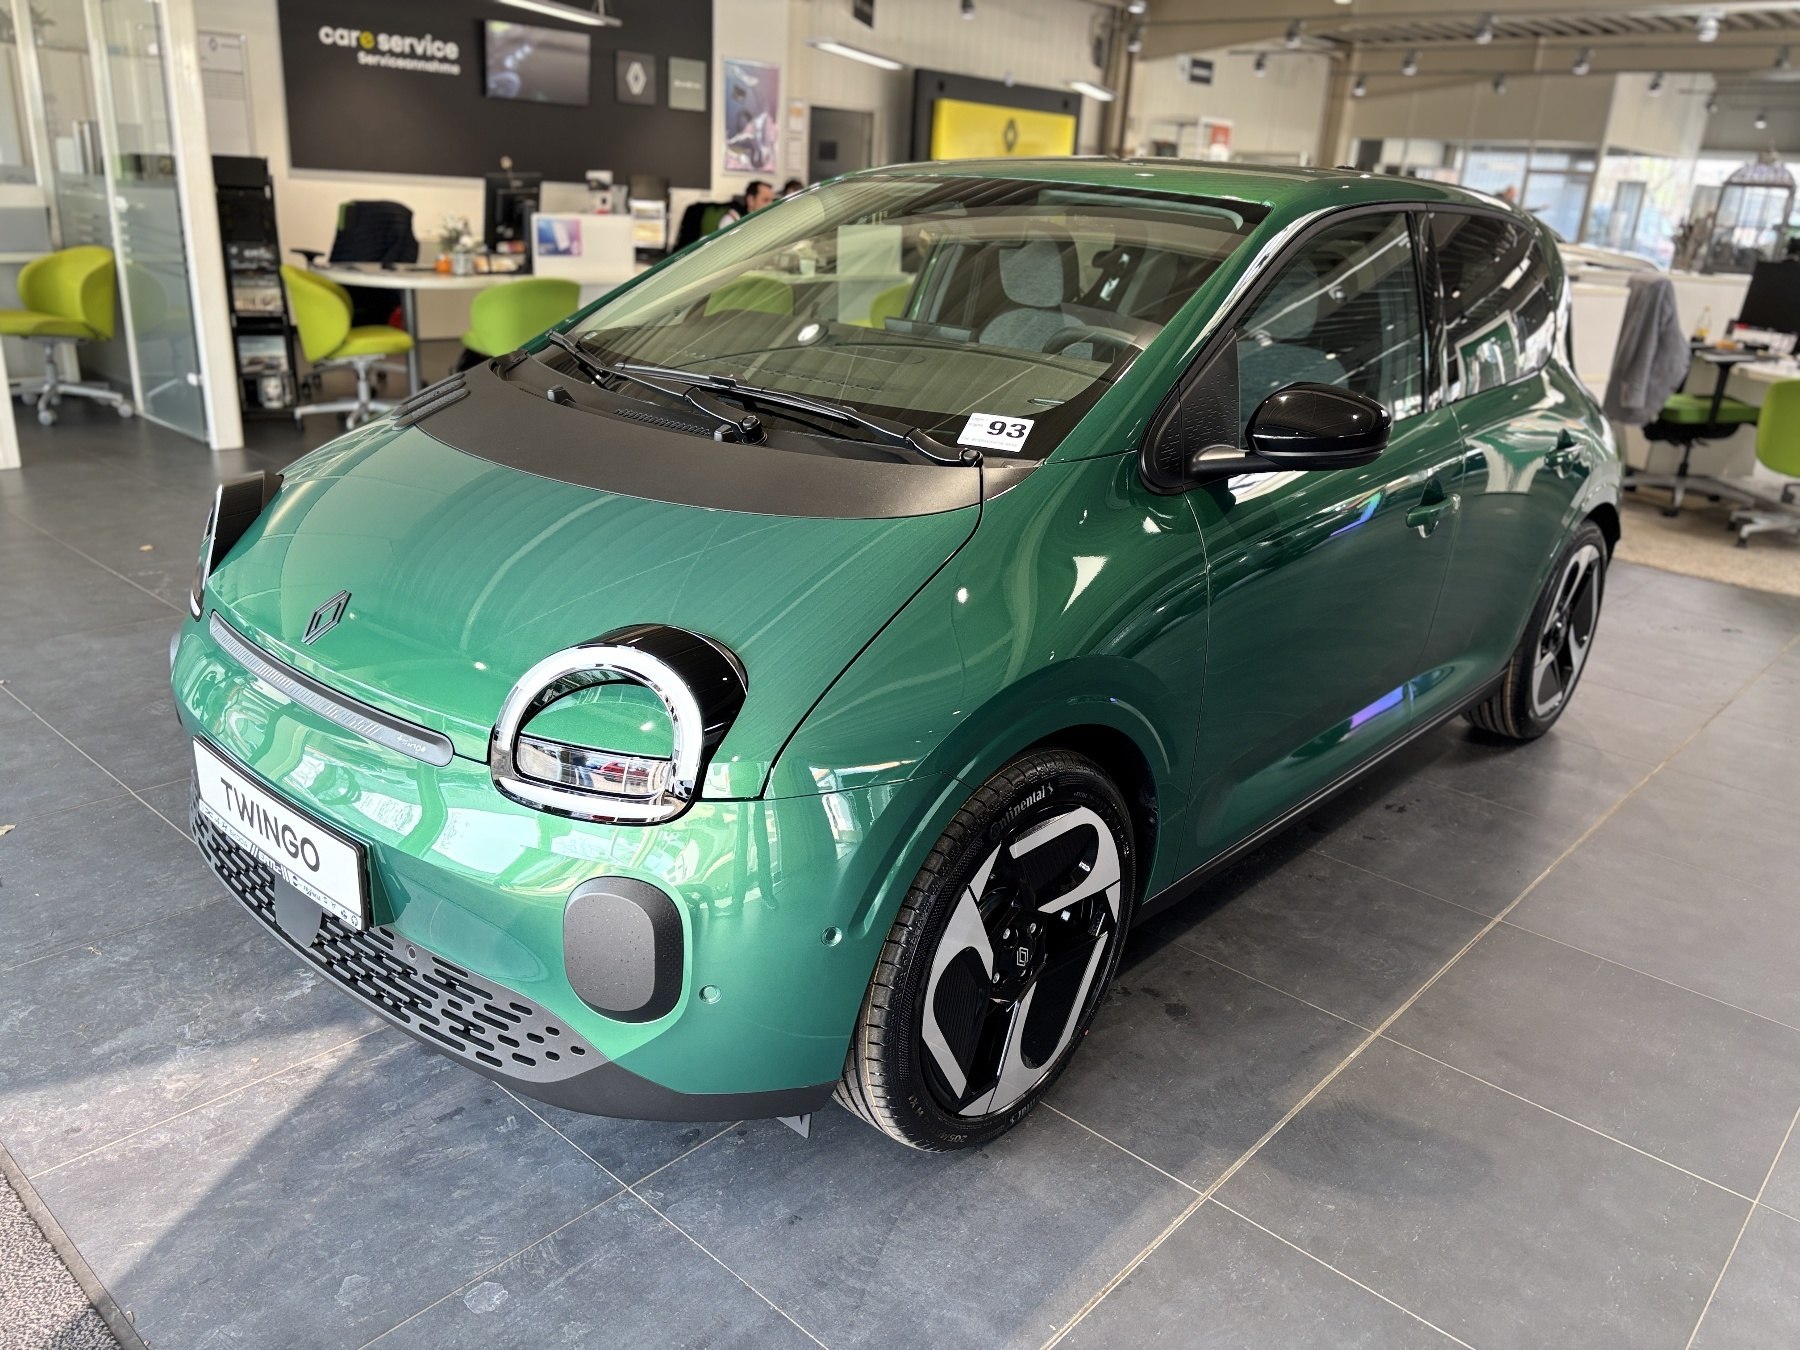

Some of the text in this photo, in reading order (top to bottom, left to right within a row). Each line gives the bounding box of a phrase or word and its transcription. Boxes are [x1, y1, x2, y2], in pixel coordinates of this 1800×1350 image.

[318, 25, 459, 60] care service
[357, 50, 461, 76] Serviceannahme
[986, 420, 1027, 438] 93
[220, 776, 320, 872] TWINGO
